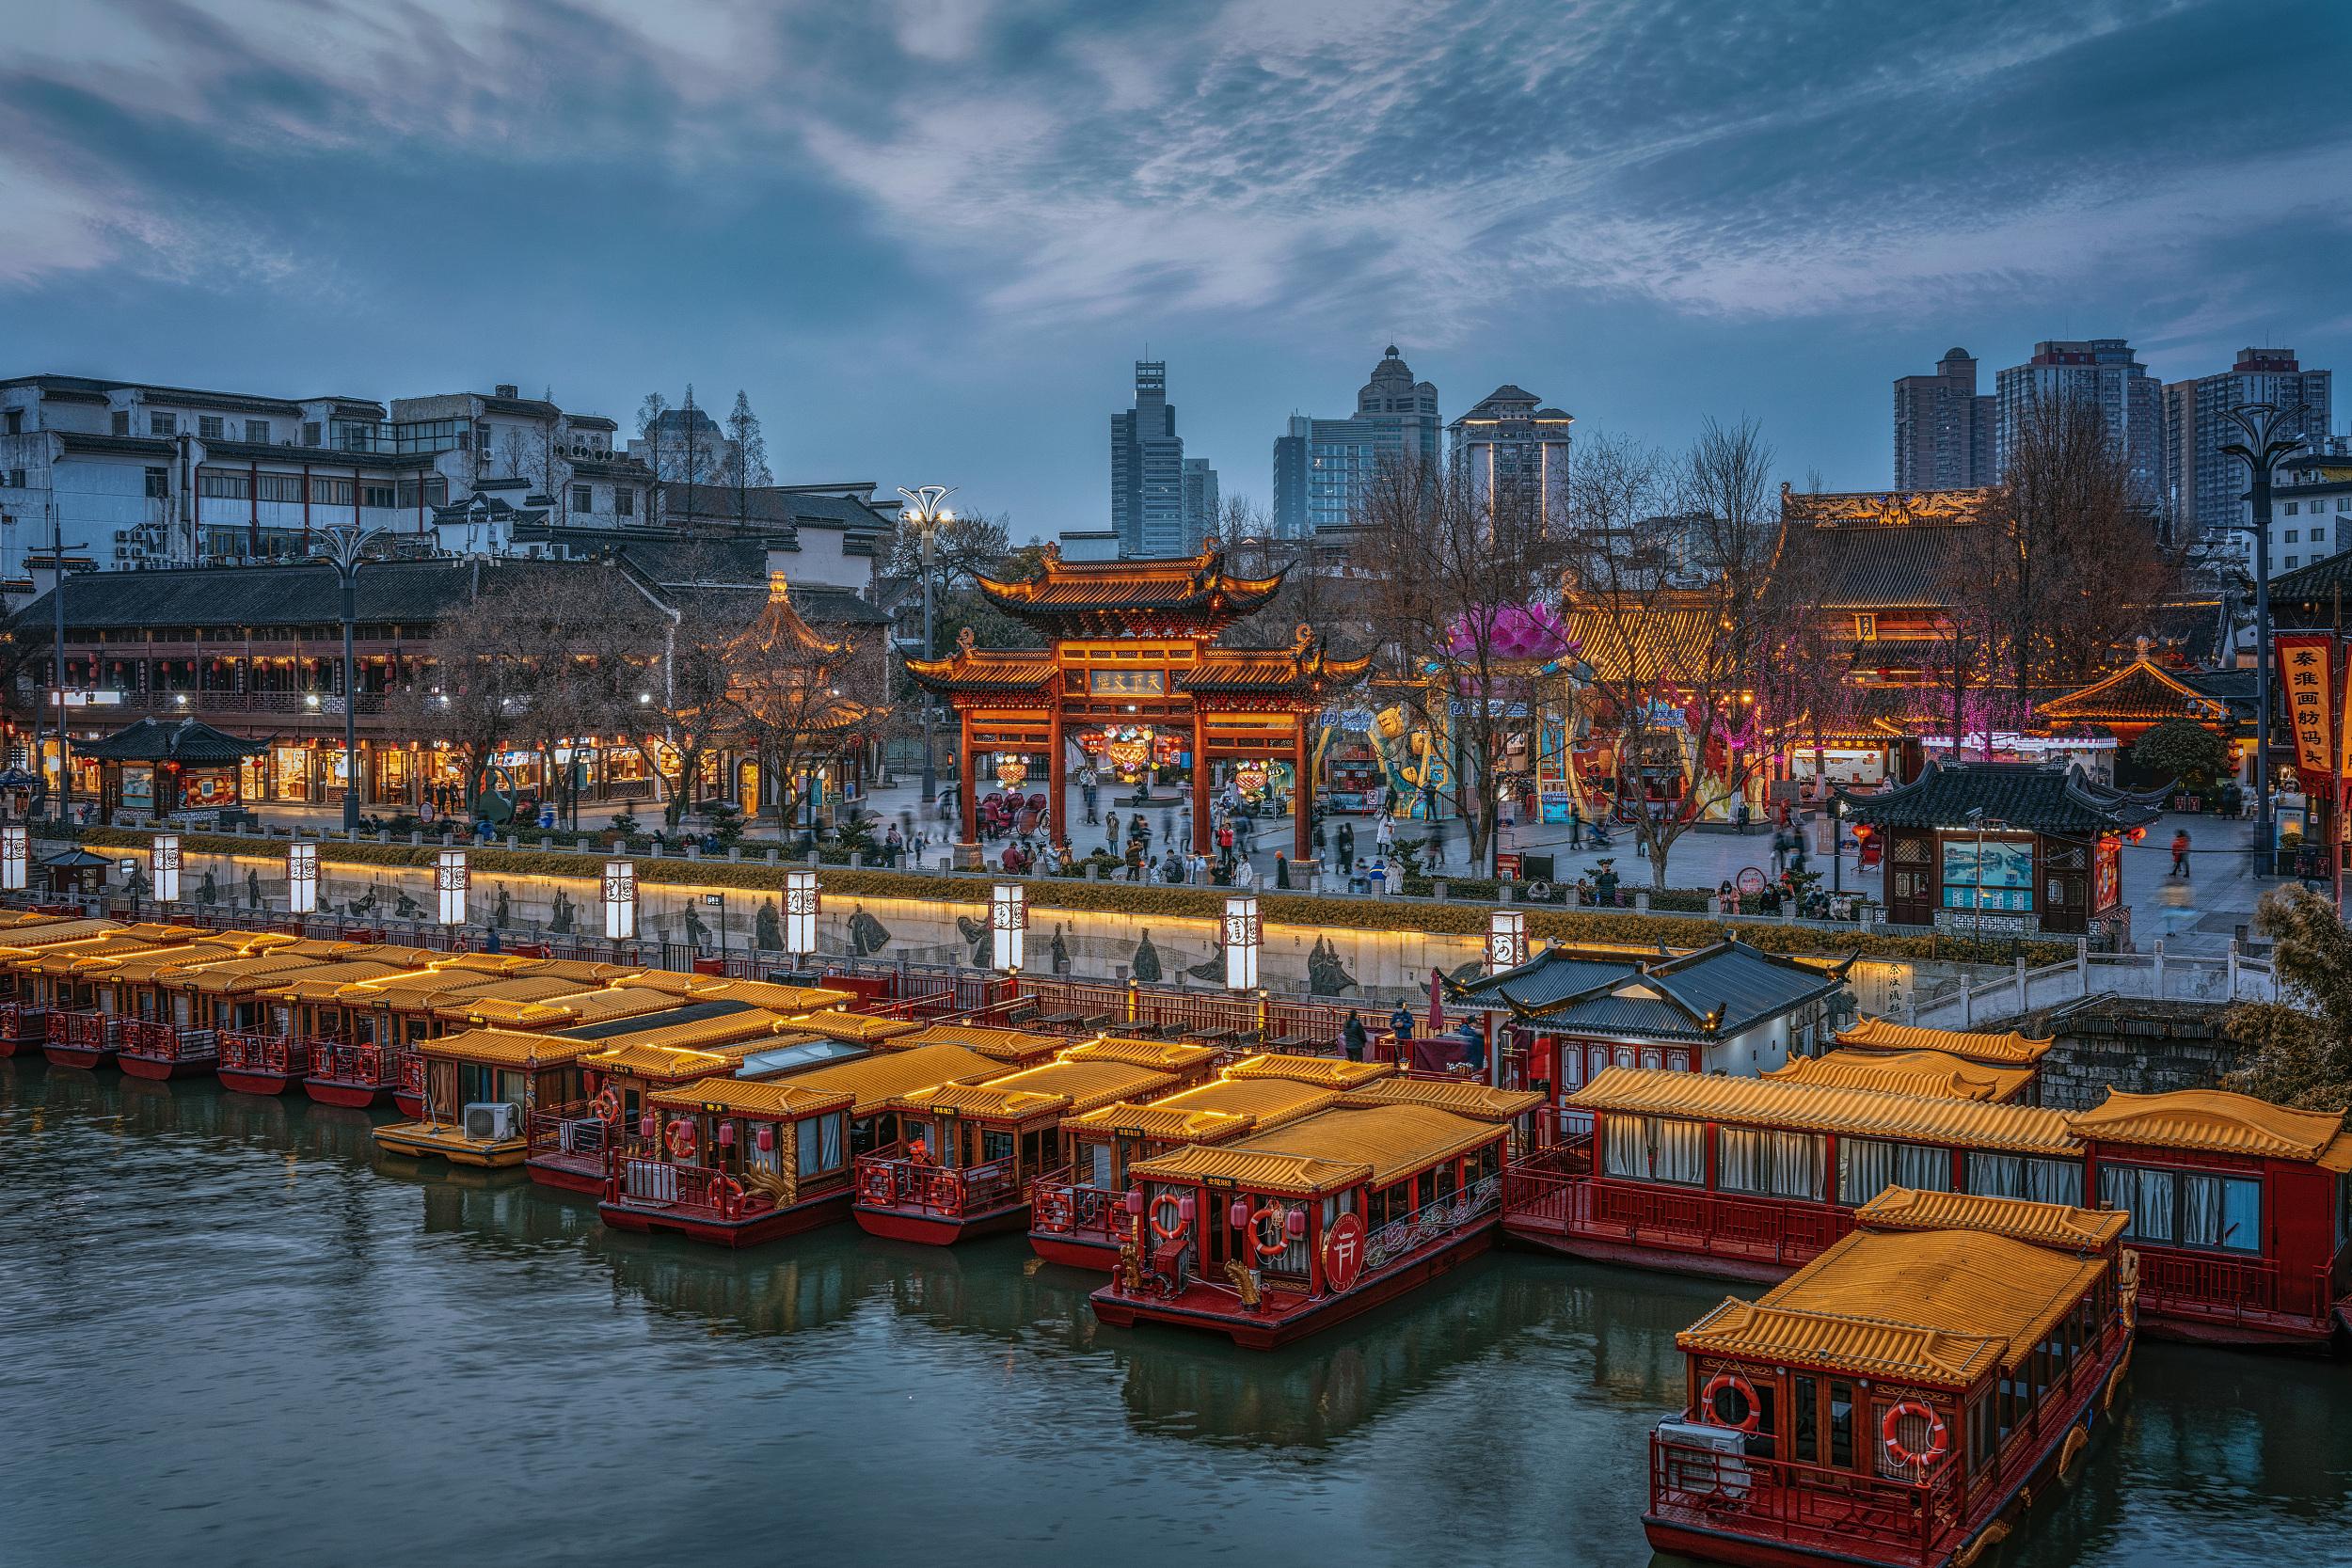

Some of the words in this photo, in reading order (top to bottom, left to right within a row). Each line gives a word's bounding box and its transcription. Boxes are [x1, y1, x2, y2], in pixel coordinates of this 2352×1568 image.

[2293, 651, 2322, 765] 秦淮画舫码头
